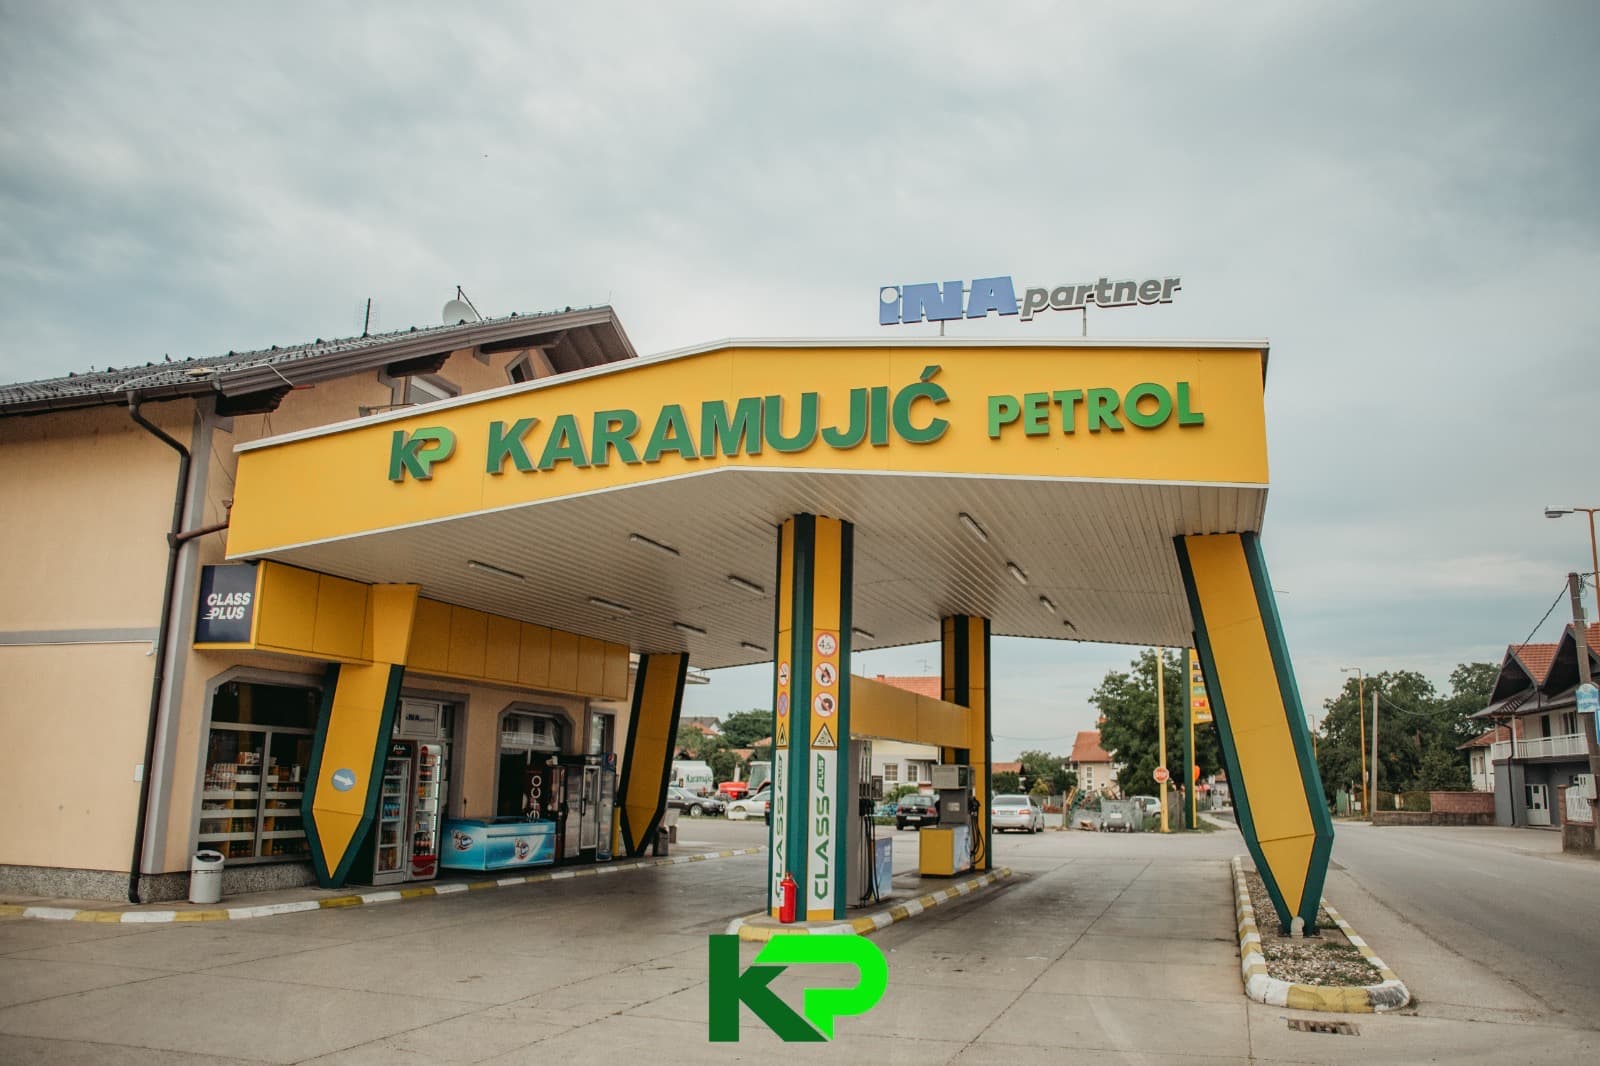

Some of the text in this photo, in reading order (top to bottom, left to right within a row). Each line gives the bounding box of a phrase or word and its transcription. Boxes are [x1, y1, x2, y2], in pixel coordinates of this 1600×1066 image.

[1019, 276, 1181, 321] partner
[388, 365, 1204, 483] KP KARAMUJIĆ PETROL
[207, 592, 251, 606] CLASS
[208, 606, 245, 620] PLUS
[815, 757, 830, 900] CLASS PLUS
